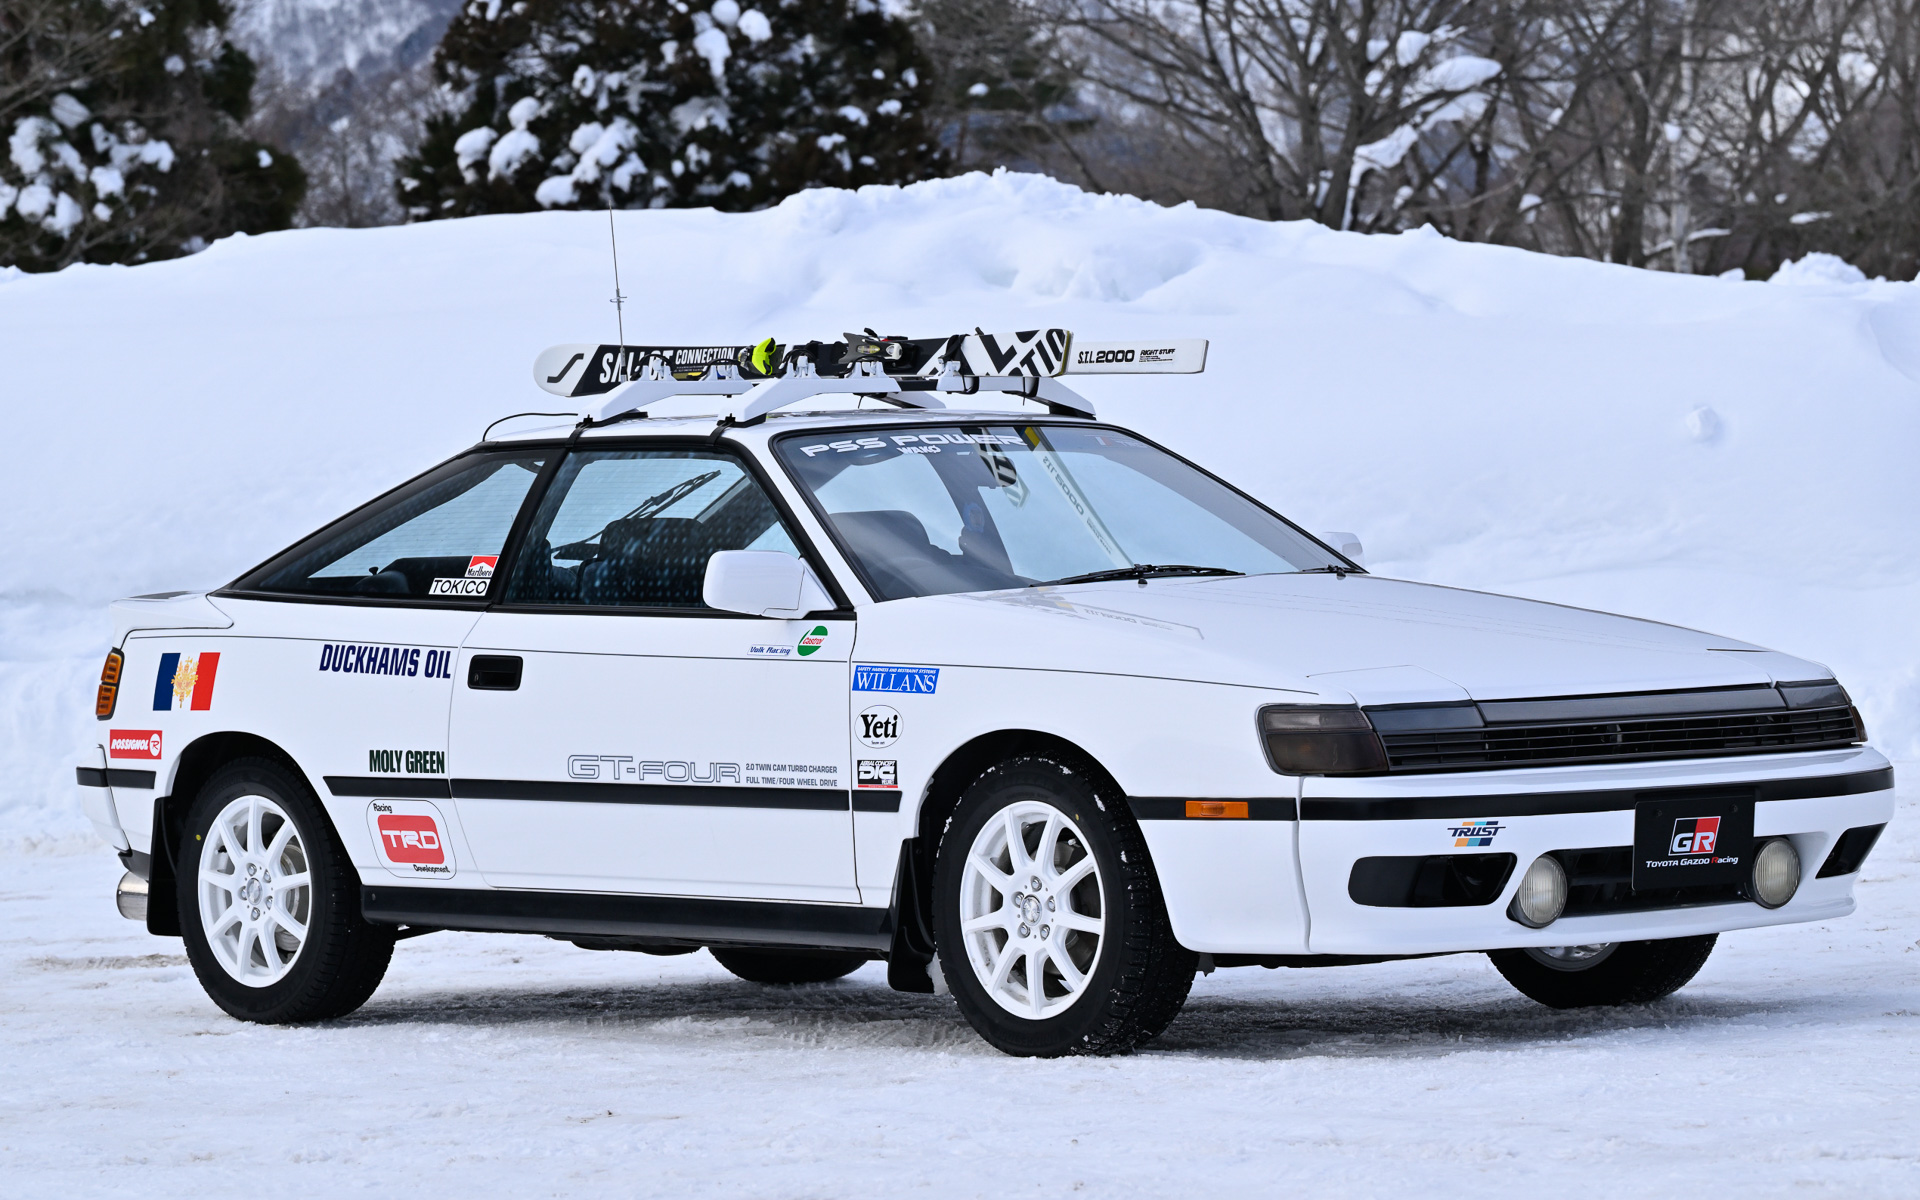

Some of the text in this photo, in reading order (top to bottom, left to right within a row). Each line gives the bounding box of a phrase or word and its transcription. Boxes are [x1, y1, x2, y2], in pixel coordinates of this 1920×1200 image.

[675, 347, 736, 366] CONNECTION
[800, 433, 1029, 458] PSS POWER
[467, 565, 492, 577] Marlboro
[432, 579, 488, 594] TOKICO
[766, 646, 791, 655] Racing
[319, 644, 451, 679] DUCKHAMS OIL
[857, 672, 935, 693] WILLANS
[860, 714, 898, 738] Yeti
[110, 738, 149, 750] ROSSIGNOL
[369, 749, 445, 774] MOLY GREEN
[567, 754, 741, 783] GT-FOUR
[745, 763, 838, 774] 2.0 TWIN CAM TURBO CHARGER
[745, 776, 760, 784] FULL
[796, 778, 818, 786] WHEEL
[819, 778, 838, 787] DRIVE
[372, 803, 393, 813] Racing
[381, 829, 440, 850] TRD
[1447, 826, 1506, 837] TRUST
[1672, 831, 1715, 853] GR
[1645, 856, 1739, 868] TOYOTA GAZOO Racing
